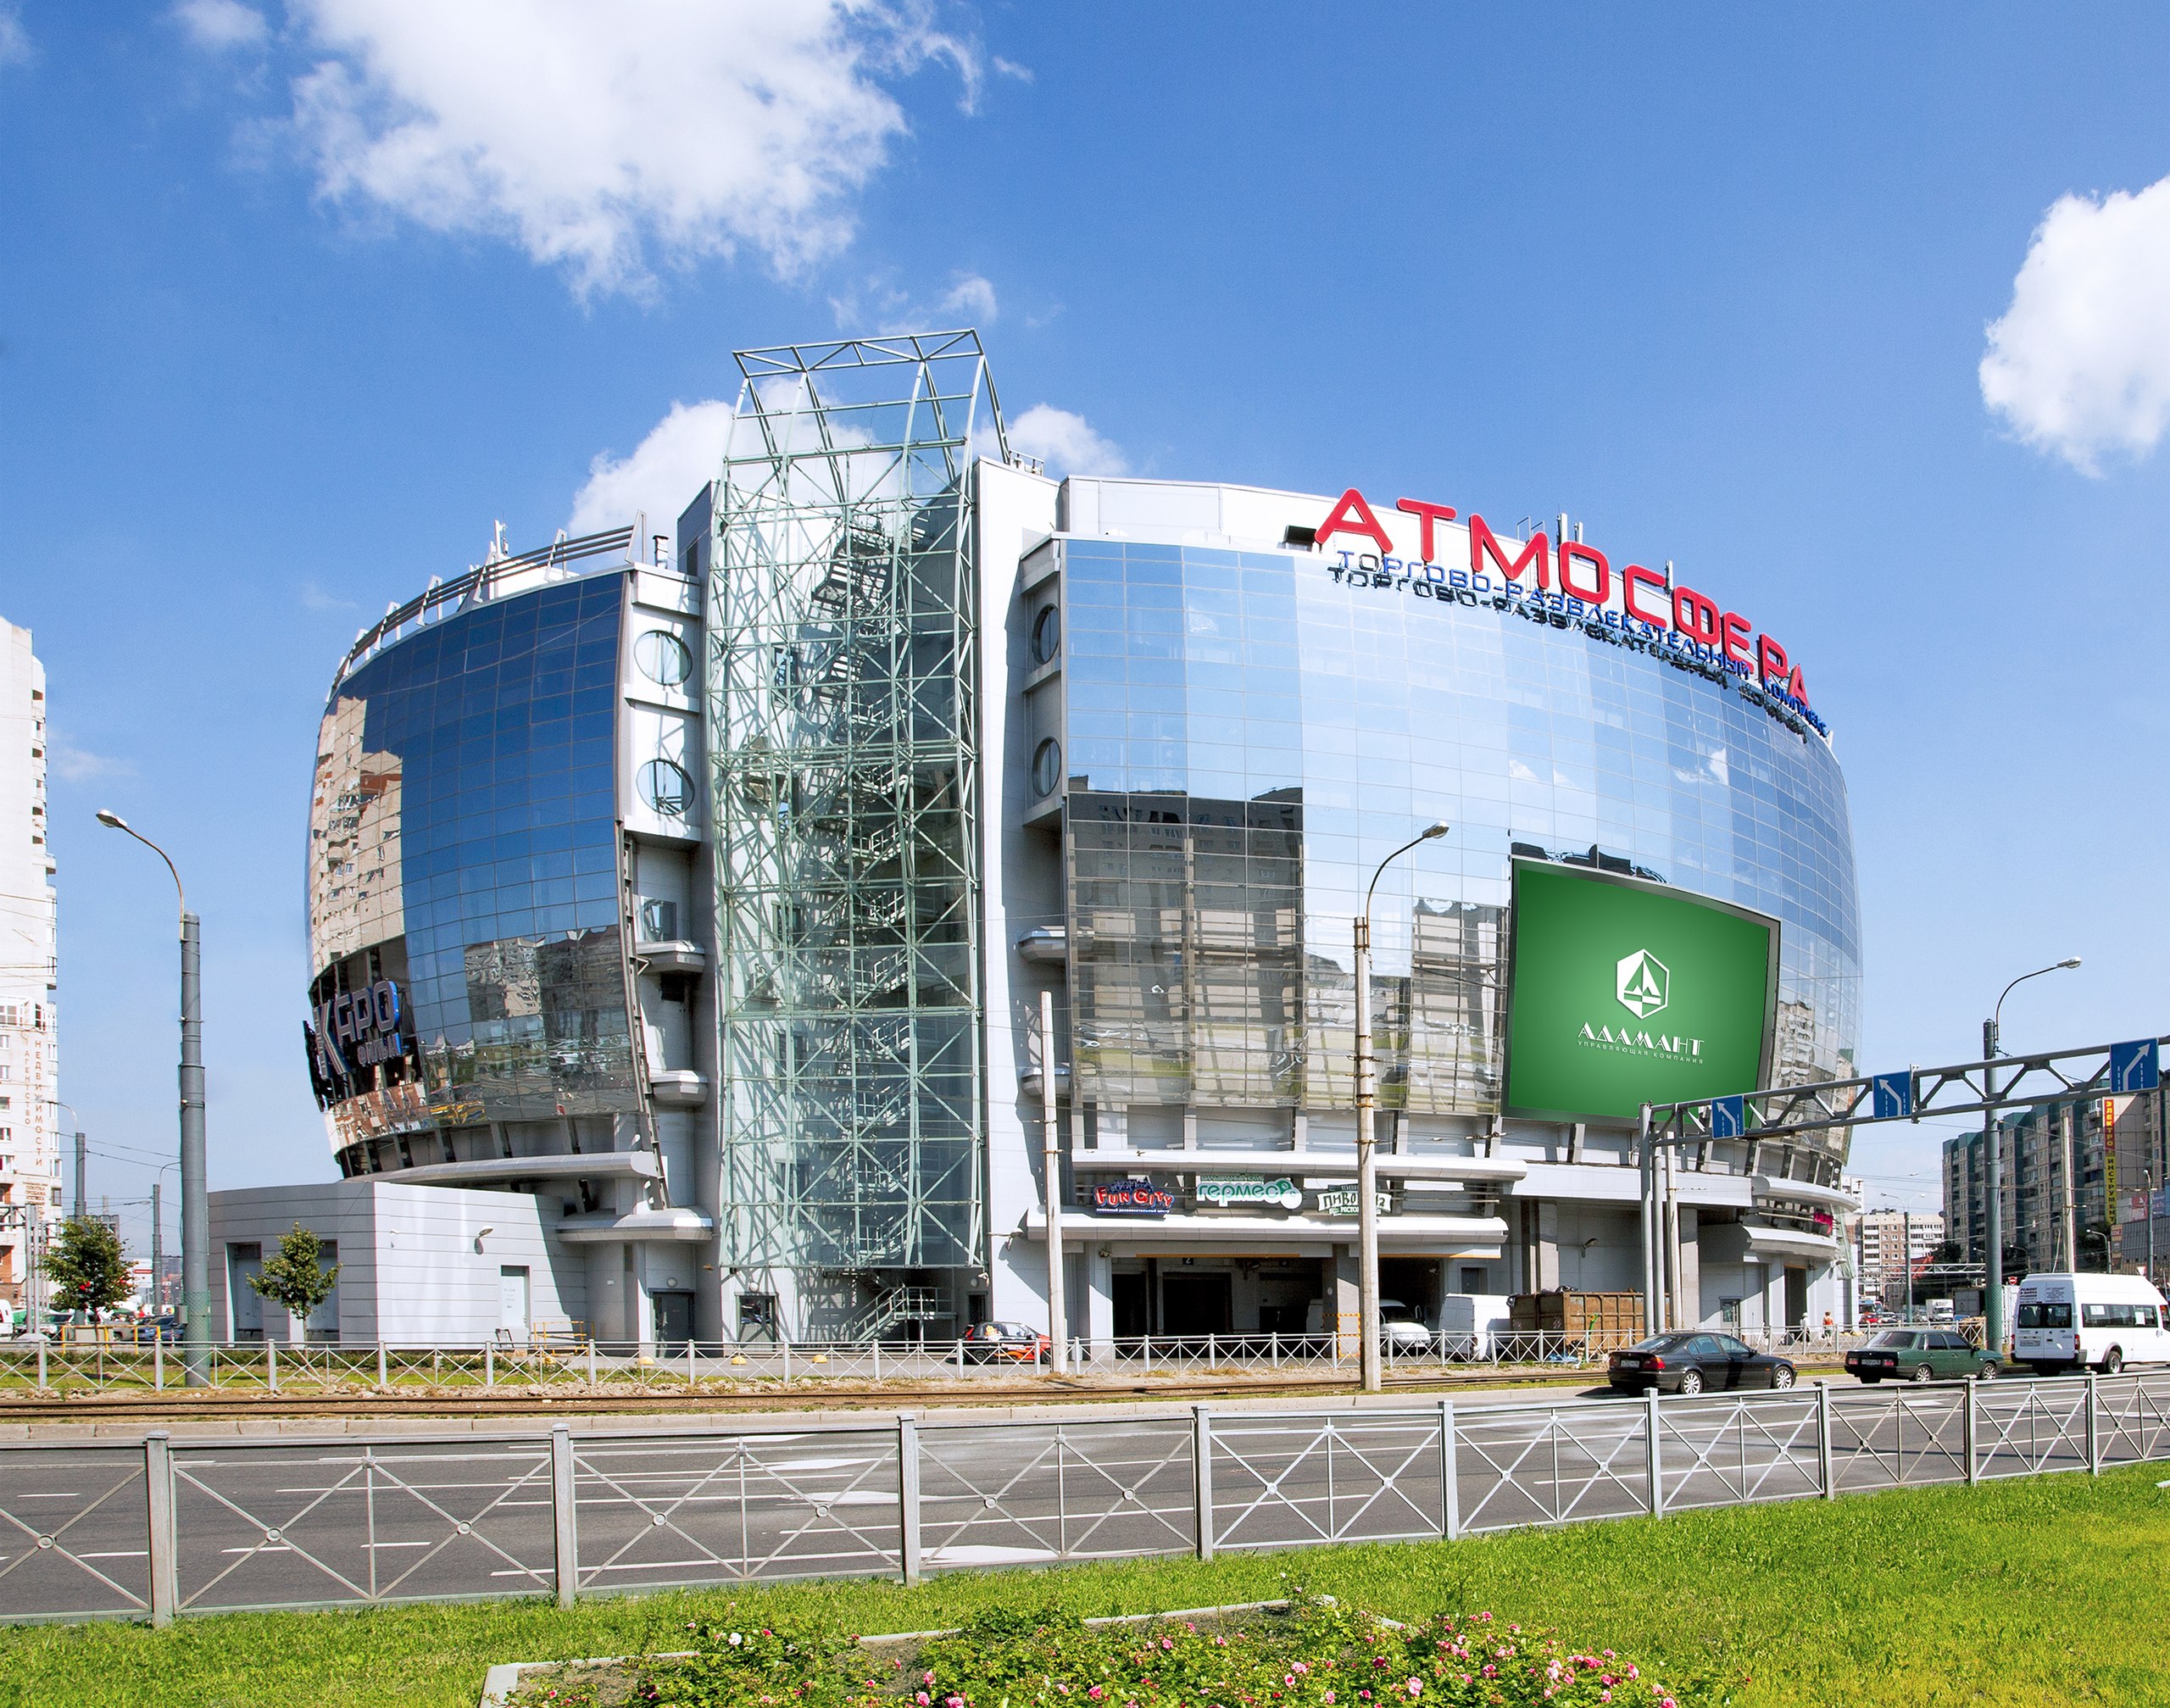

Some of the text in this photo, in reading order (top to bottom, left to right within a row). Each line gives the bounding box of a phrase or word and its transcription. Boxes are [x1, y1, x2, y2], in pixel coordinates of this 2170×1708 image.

[1316, 487, 1810, 709] АТМОСФЕРА
[1337, 549, 1829, 737] ТОРГОВО-РАЗВЛЕКАТЕЛЬНЫЙ КОМПЛЕКС
[1577, 1021, 1705, 1056] АДАМАНТ
[1577, 1041, 1703, 1065] УПРАВЛЯЮЩАЯ КОМПАНИЯ
[2106, 1100, 2114, 1147] ЭЛЕКТРО
[1095, 1186, 1129, 1205] FUN
[1132, 1188, 1173, 1208] CITY
[1199, 1183, 1279, 1204] гермес
[2107, 1158, 2117, 1222] ИНСТРУМЕНТ
